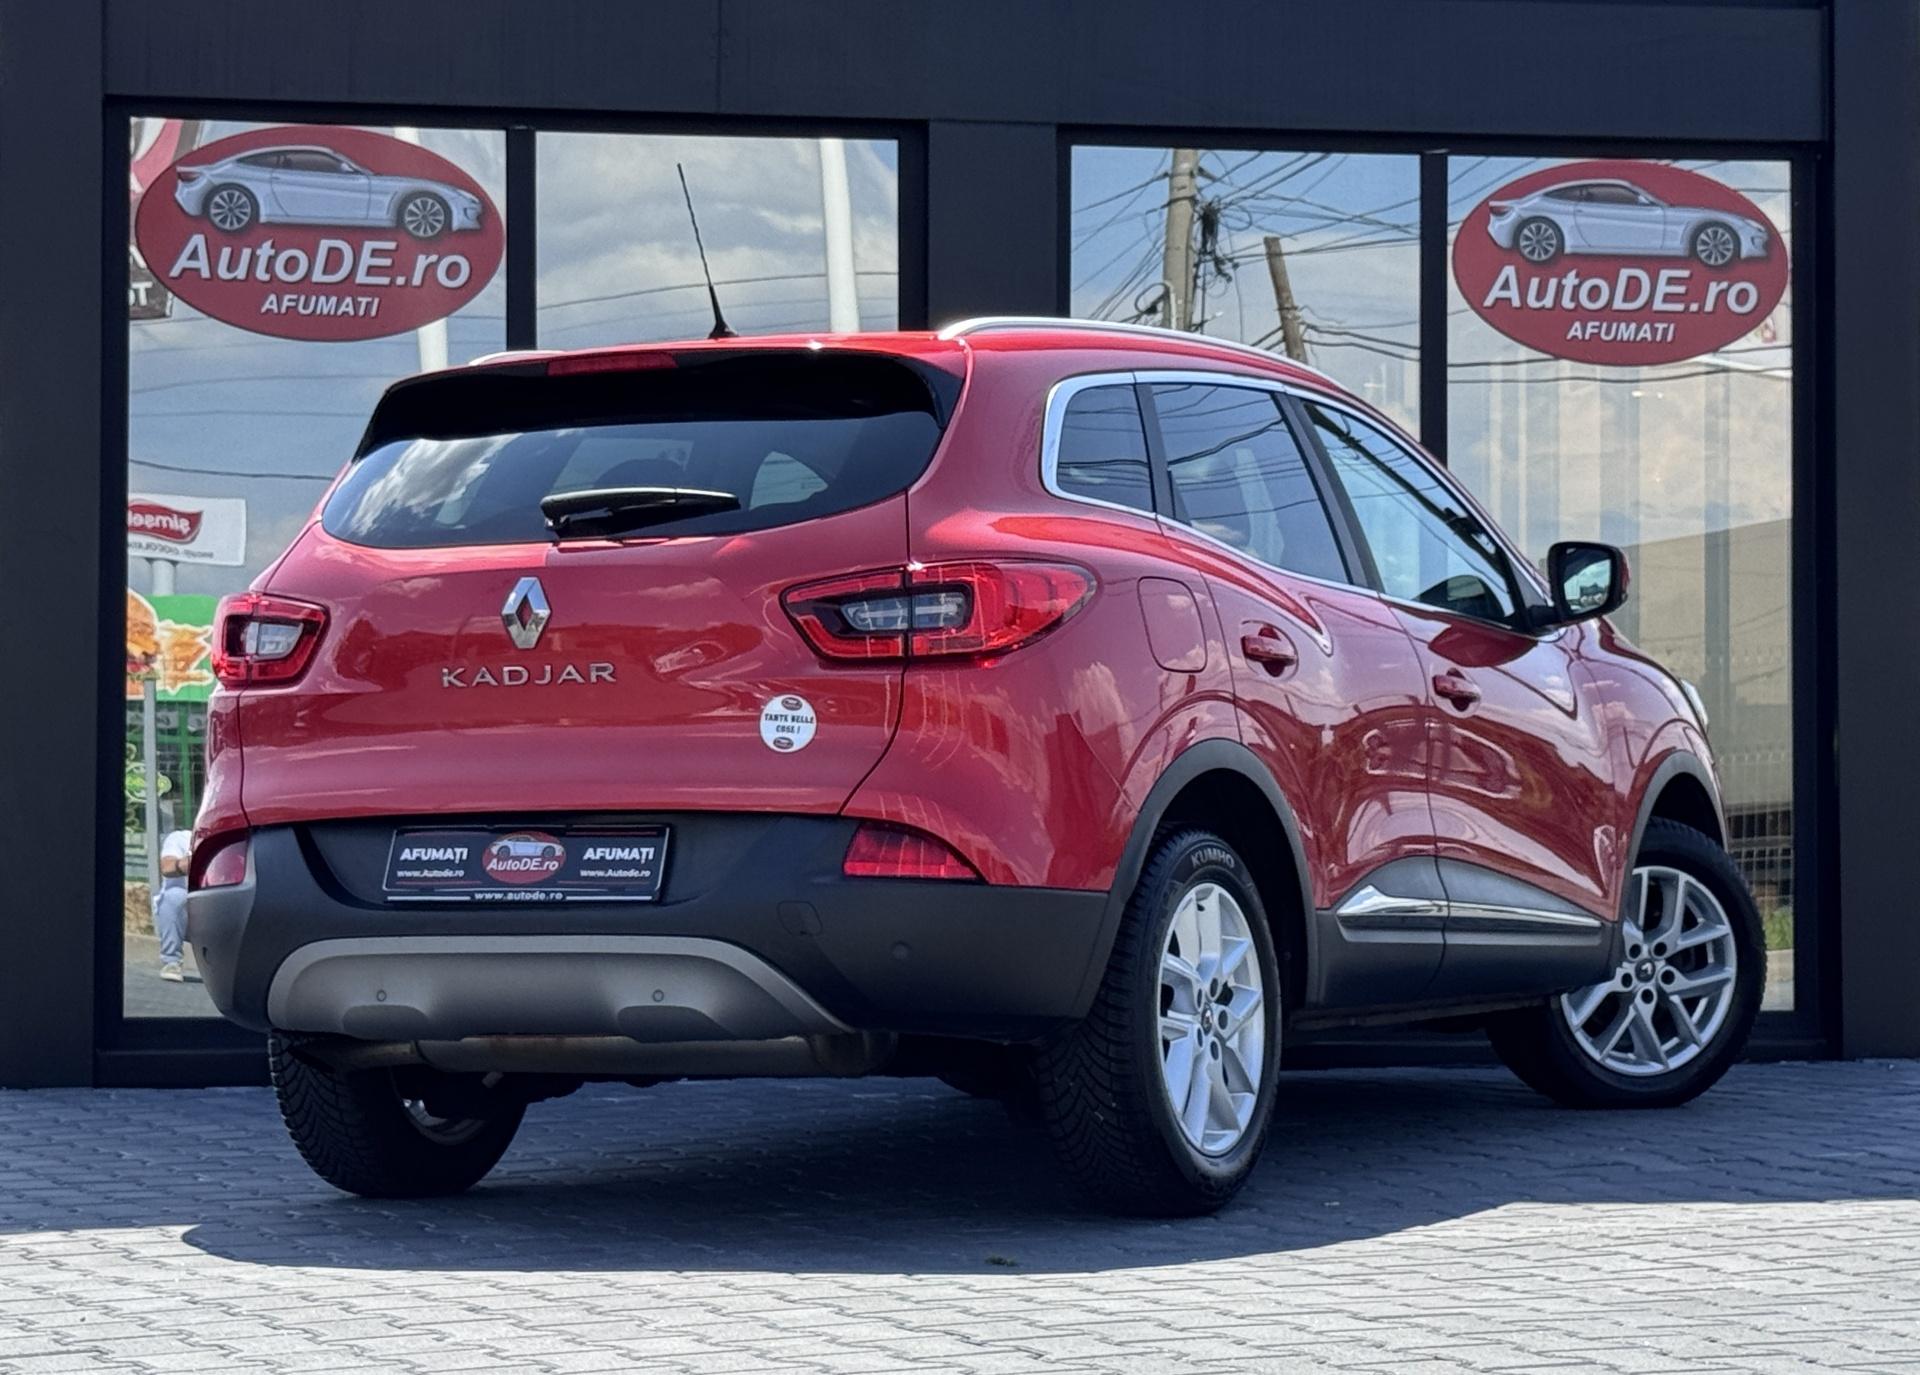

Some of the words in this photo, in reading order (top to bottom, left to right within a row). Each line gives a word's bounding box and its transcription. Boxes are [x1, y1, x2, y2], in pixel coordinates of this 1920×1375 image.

[169, 234, 471, 288] AutoDE.ro
[1482, 265, 1759, 314] AutoDE.ro
[261, 294, 380, 318] AFUMATI
[1566, 321, 1676, 343] AFUMATI
[442, 662, 617, 688] KADJAR
[486, 858, 559, 871] AutoDE.ro
[1191, 847, 1235, 869] KUMHO
[474, 891, 563, 900] www.autode.ro
